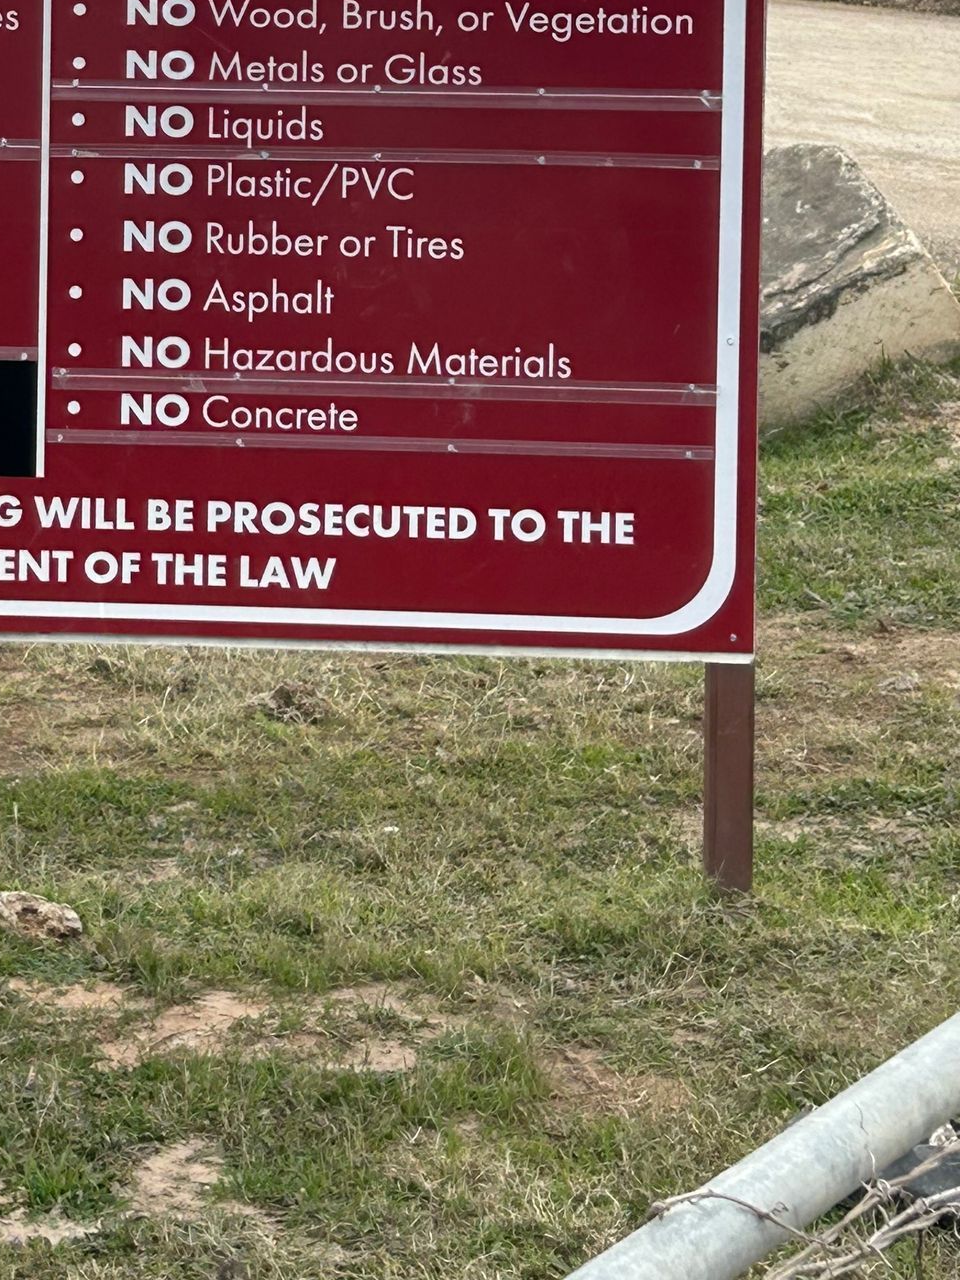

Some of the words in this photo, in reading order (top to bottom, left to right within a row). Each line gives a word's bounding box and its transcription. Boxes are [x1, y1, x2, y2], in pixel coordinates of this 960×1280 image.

[457, 11, 495, 32] or
[504, 1, 693, 43] Vegetation
[125, 49, 195, 81] NO
[208, 49, 325, 83] Metals
[336, 63, 374, 84] or
[384, 51, 482, 86] Glass
[125, 104, 194, 138] NO
[208, 105, 324, 149] Liquids
[124, 162, 193, 196] NO
[207, 161, 414, 207] Plastic/PVC
[123, 220, 193, 254] NO
[206, 219, 329, 257] Rubber
[339, 235, 377, 258] or
[385, 225, 465, 260] Tires
[122, 277, 192, 312] NO
[202, 278, 335, 323] Asphalt
[121, 335, 191, 369] NO
[204, 337, 395, 374] Hazardous
[407, 342, 572, 379] Materials
[120, 393, 190, 427] NO
[202, 395, 359, 431] Concrete
[33, 495, 135, 530] WILL
[147, 498, 194, 532] BE
[207, 500, 477, 540] PROSECUTED
[487, 508, 546, 543] TO
[557, 510, 635, 545] THE
[84, 550, 141, 584] OF
[151, 552, 227, 587] THE
[239, 555, 337, 590] LAW
